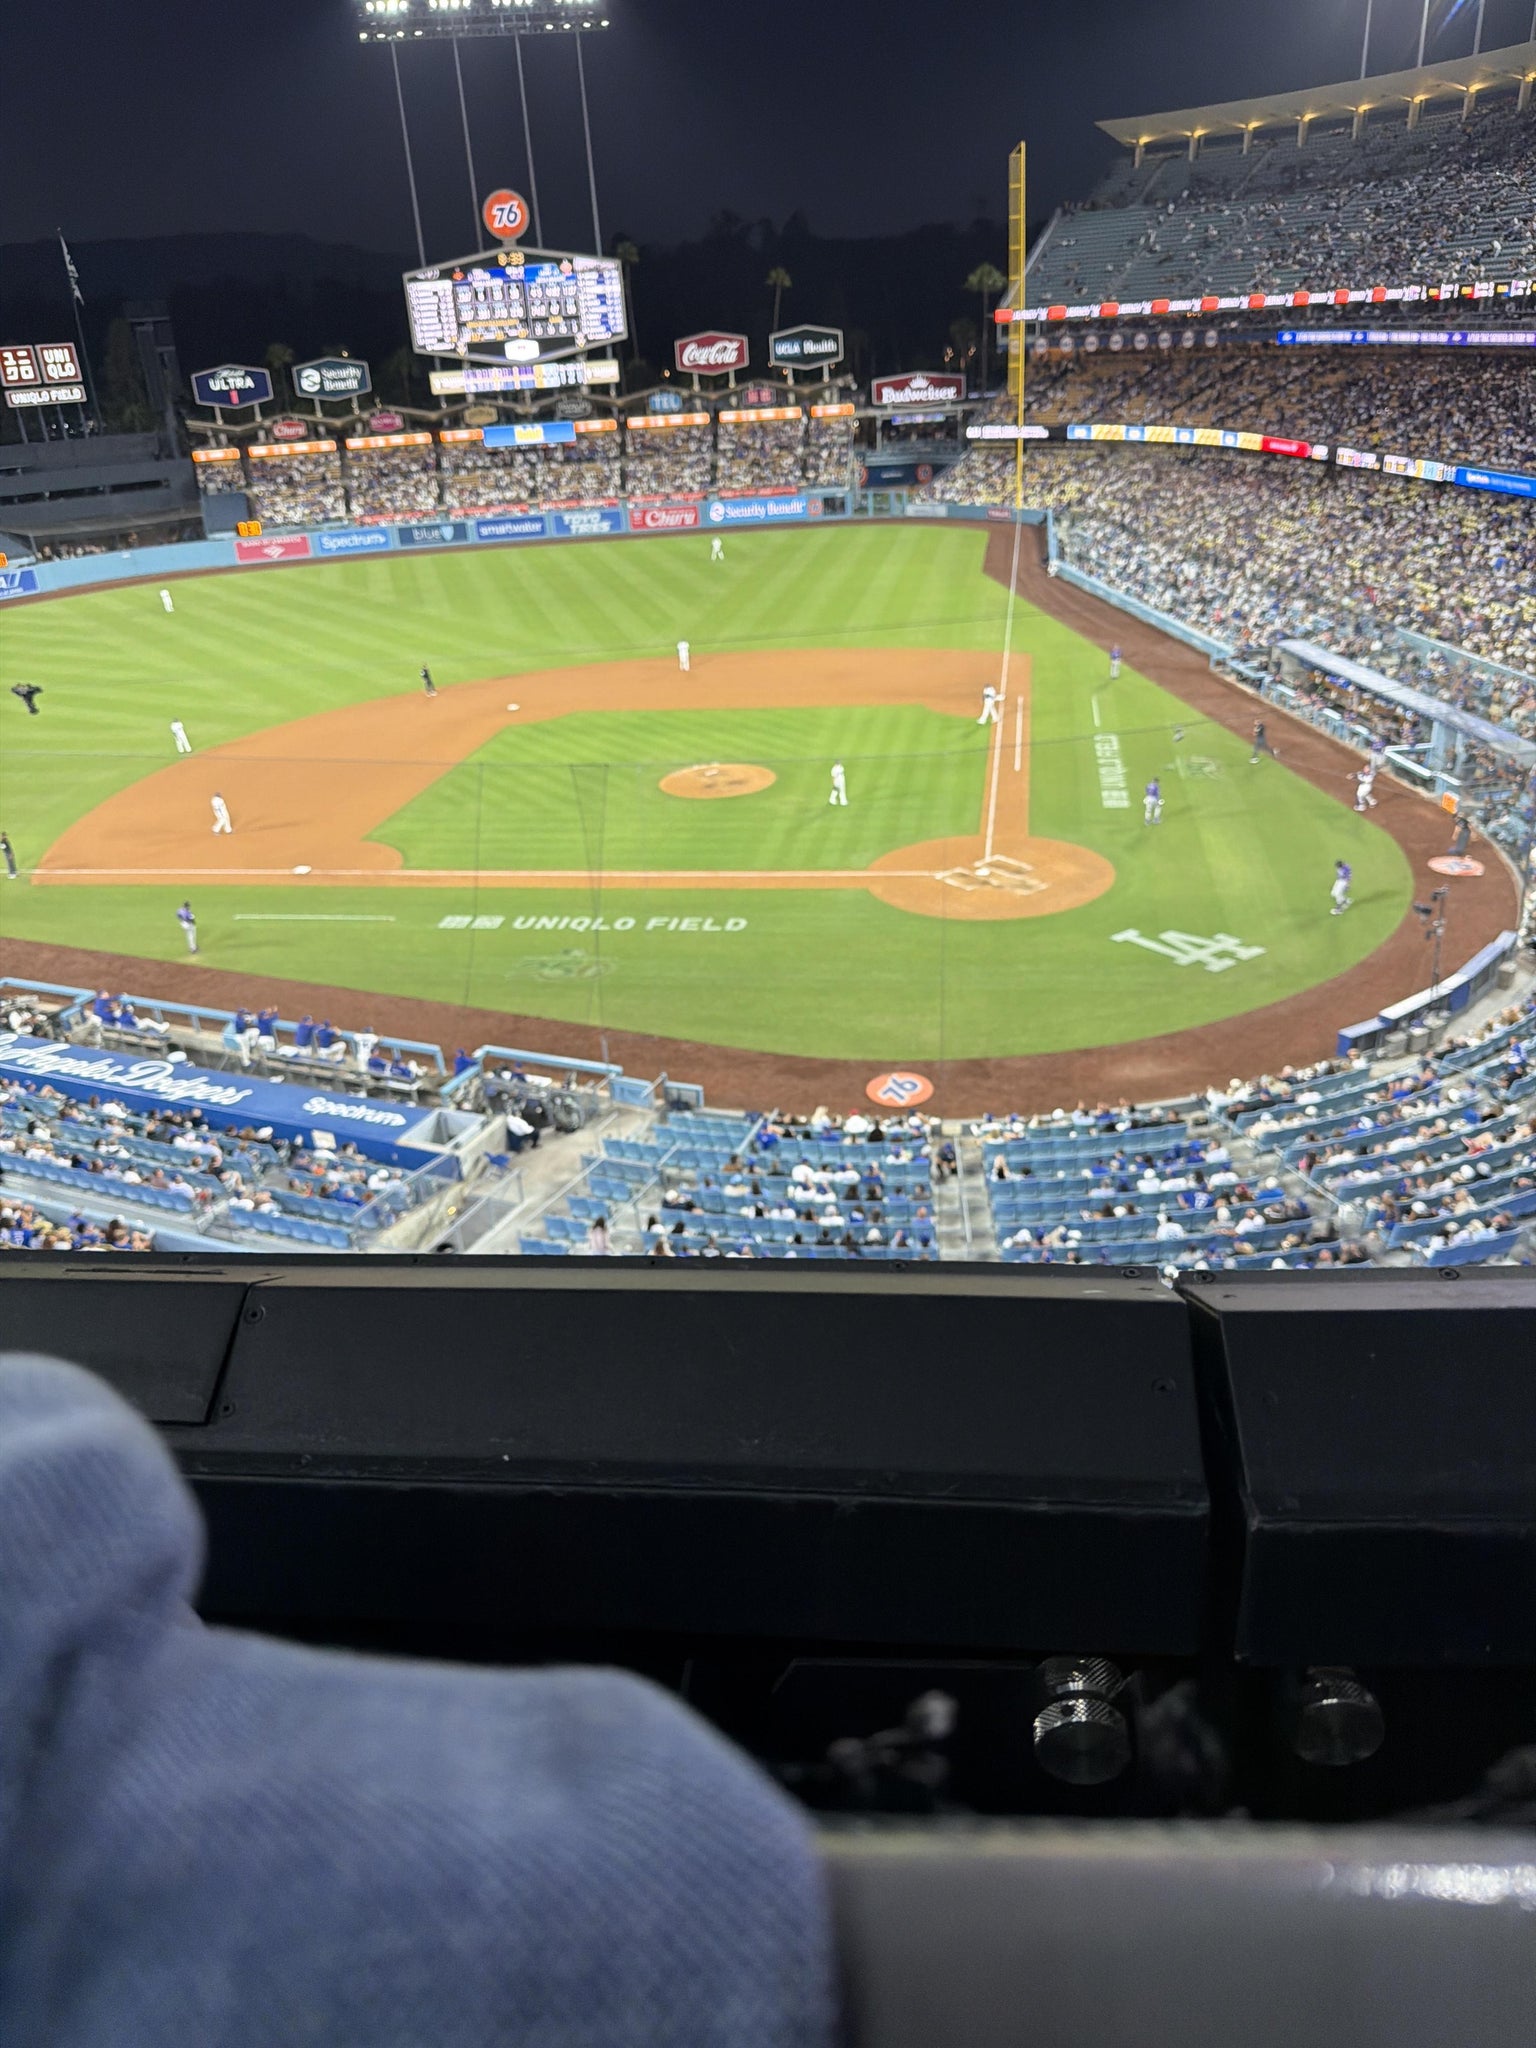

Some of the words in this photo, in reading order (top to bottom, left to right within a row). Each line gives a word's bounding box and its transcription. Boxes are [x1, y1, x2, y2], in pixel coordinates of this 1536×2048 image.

[493, 202, 520, 227] 76
[43, 348, 71, 363] UNI
[47, 362, 76, 379] QLO
[208, 375, 255, 391] ULTRA
[11, 391, 50, 404] UNIQLO
[50, 388, 82, 401] FIELD
[881, 384, 957, 403] Budweiser
[725, 502, 767, 519] Security
[479, 521, 542, 537] smartwater
[321, 532, 386, 551] Spectrum
[511, 915, 636, 933] UNIQLO
[645, 916, 748, 932] FIELD
[1108, 928, 1267, 973] LA
[120, 1060, 253, 1105] Dodgers
[880, 1072, 923, 1105] 76
[302, 1096, 407, 1127] Spectrum
